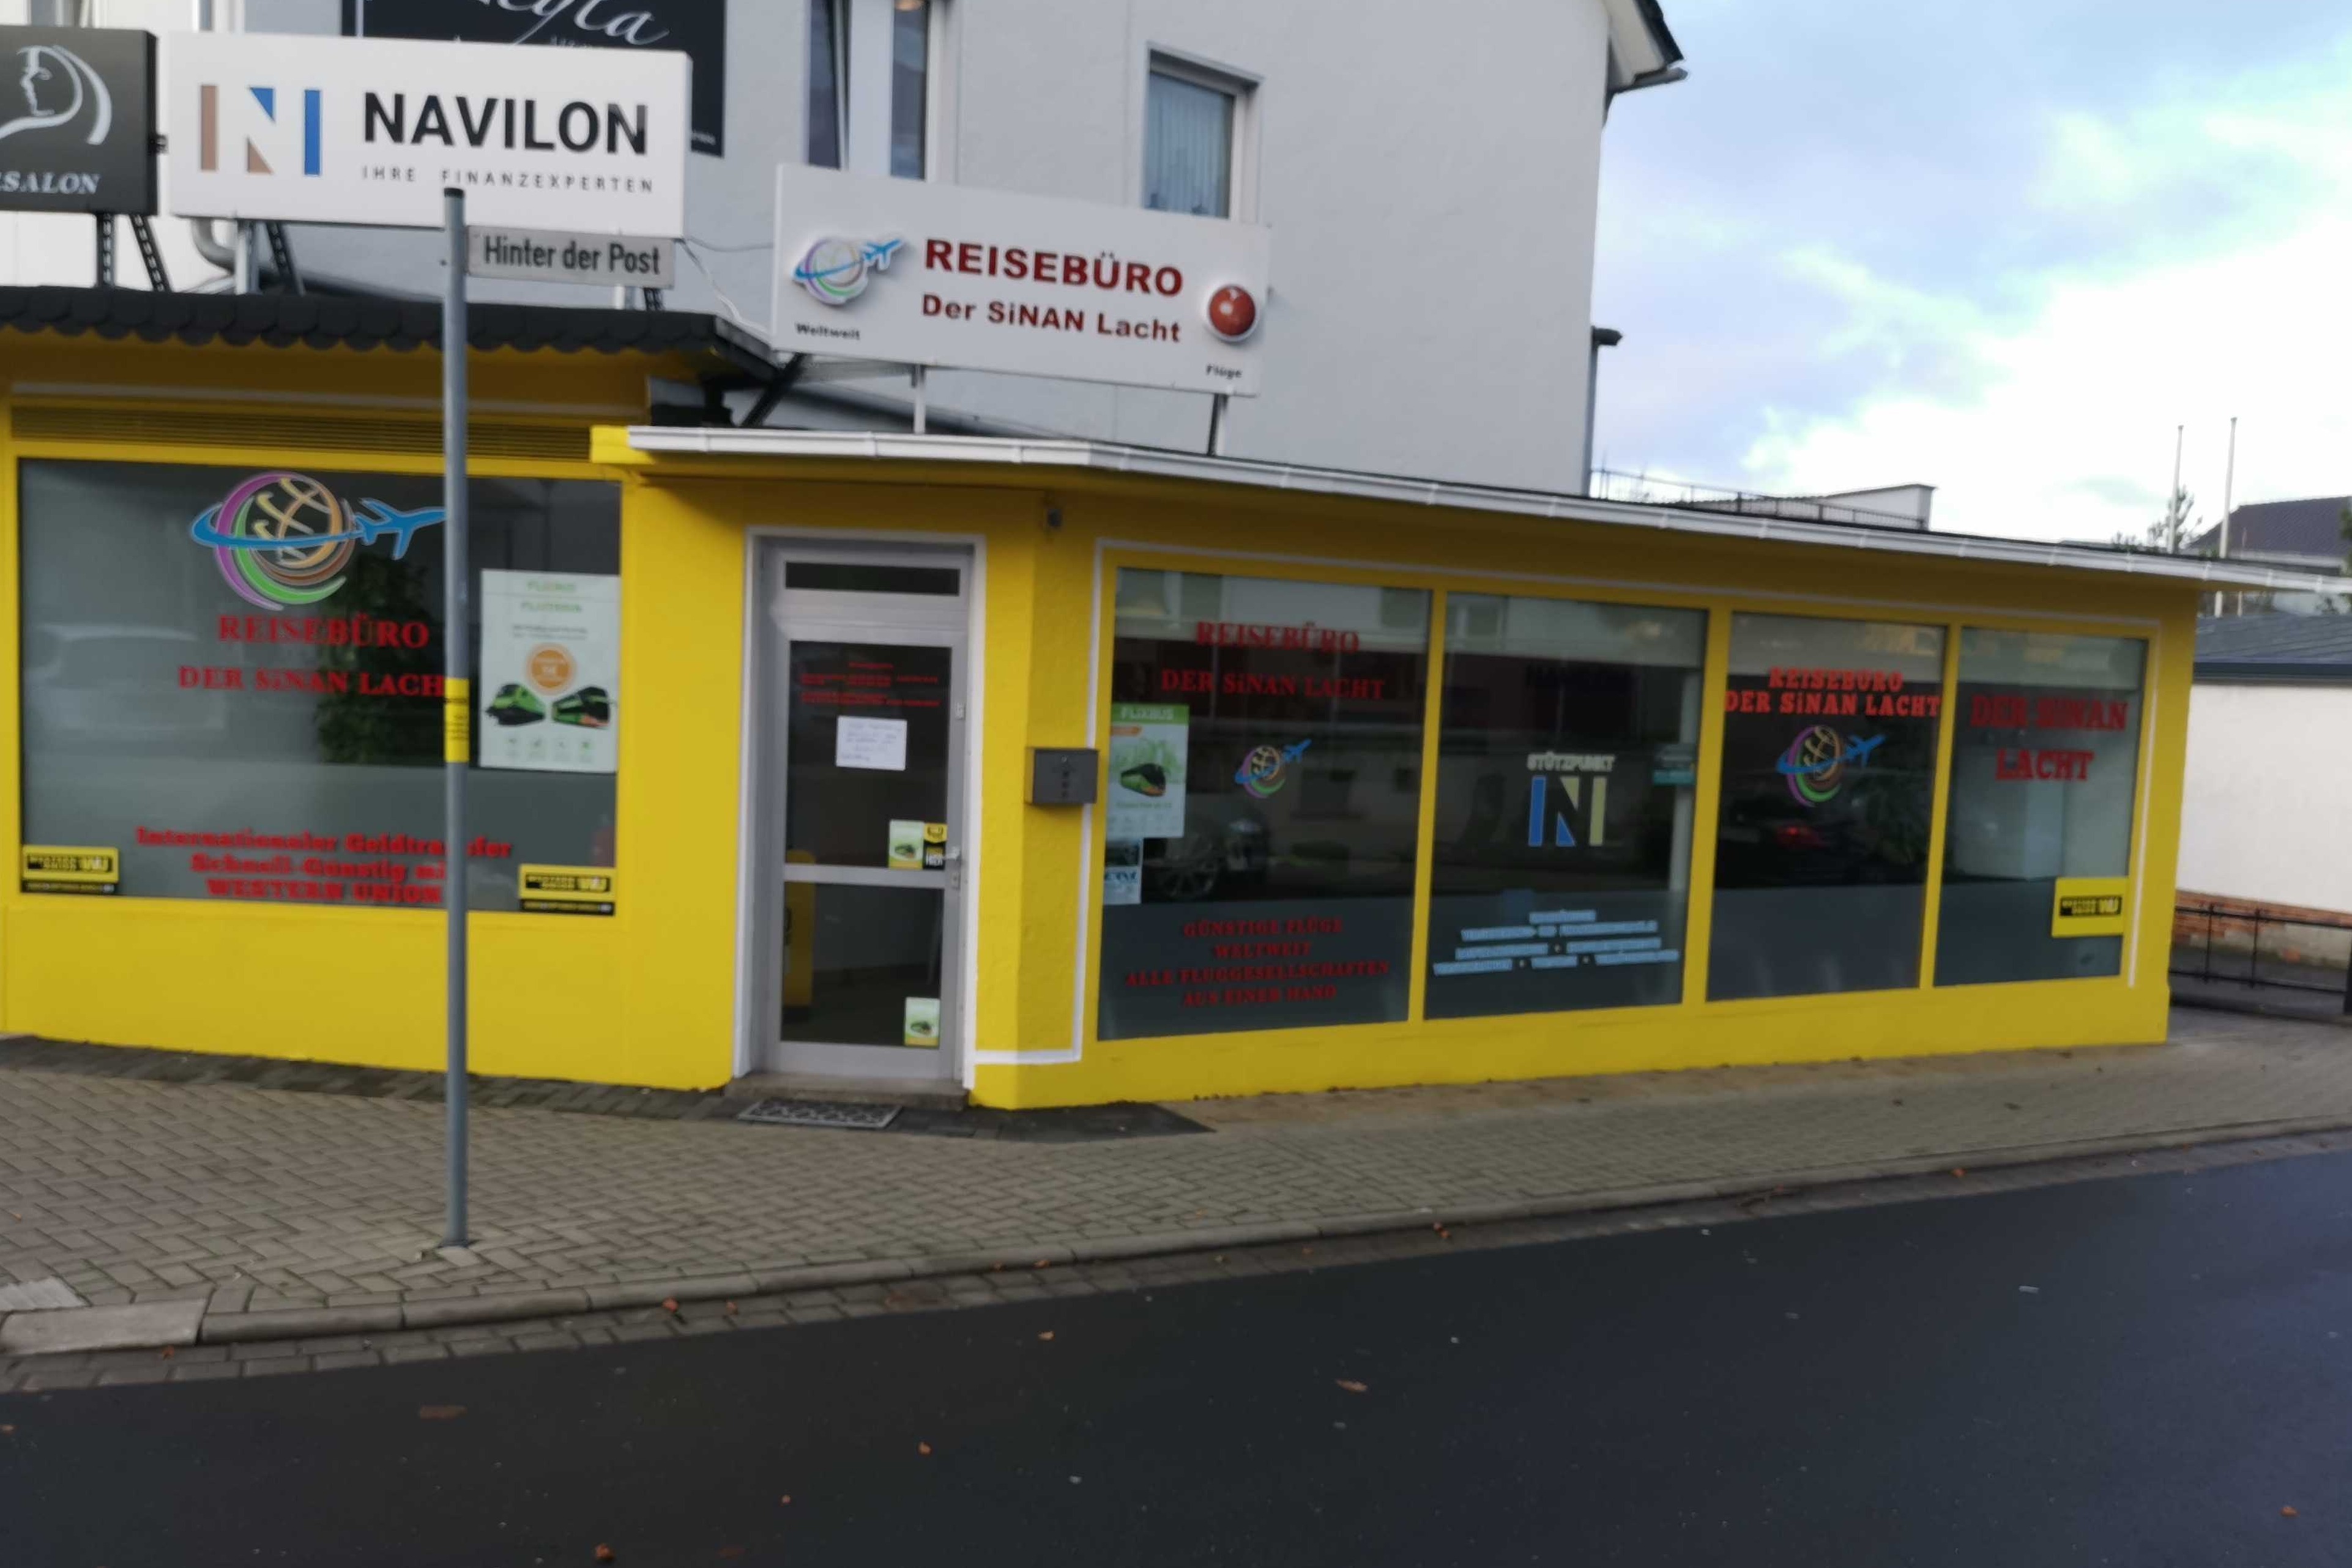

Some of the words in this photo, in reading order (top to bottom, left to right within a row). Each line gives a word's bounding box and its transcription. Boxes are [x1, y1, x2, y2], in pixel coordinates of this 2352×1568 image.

[365, 92, 647, 155] NAVILON
[0, 171, 100, 194] SALON
[363, 166, 415, 182] IHRE
[442, 169, 652, 193] FINANZEXPERTEN
[484, 235, 555, 269] Hinter
[562, 240, 601, 271] der
[609, 242, 660, 275] Post
[924, 239, 1184, 297] REISEBÜRO
[921, 293, 977, 322] Der
[988, 301, 1085, 332] SiNAN
[1096, 314, 1181, 343] Lacht
[218, 612, 430, 649] REISEBÜRO
[1195, 620, 1360, 654] REISEBÜRO
[178, 666, 244, 690] DER
[359, 672, 445, 697] LACH
[1161, 668, 1215, 693] DER
[1304, 676, 1385, 700] LACHT
[1725, 689, 1771, 713] DER
[1865, 696, 1941, 716] LACHT
[1970, 694, 2029, 729] DER
[1995, 748, 2095, 781] LACHT
[136, 825, 337, 850] Internationaler
[415, 860, 446, 880] mi
[207, 879, 342, 900] WESTERN
